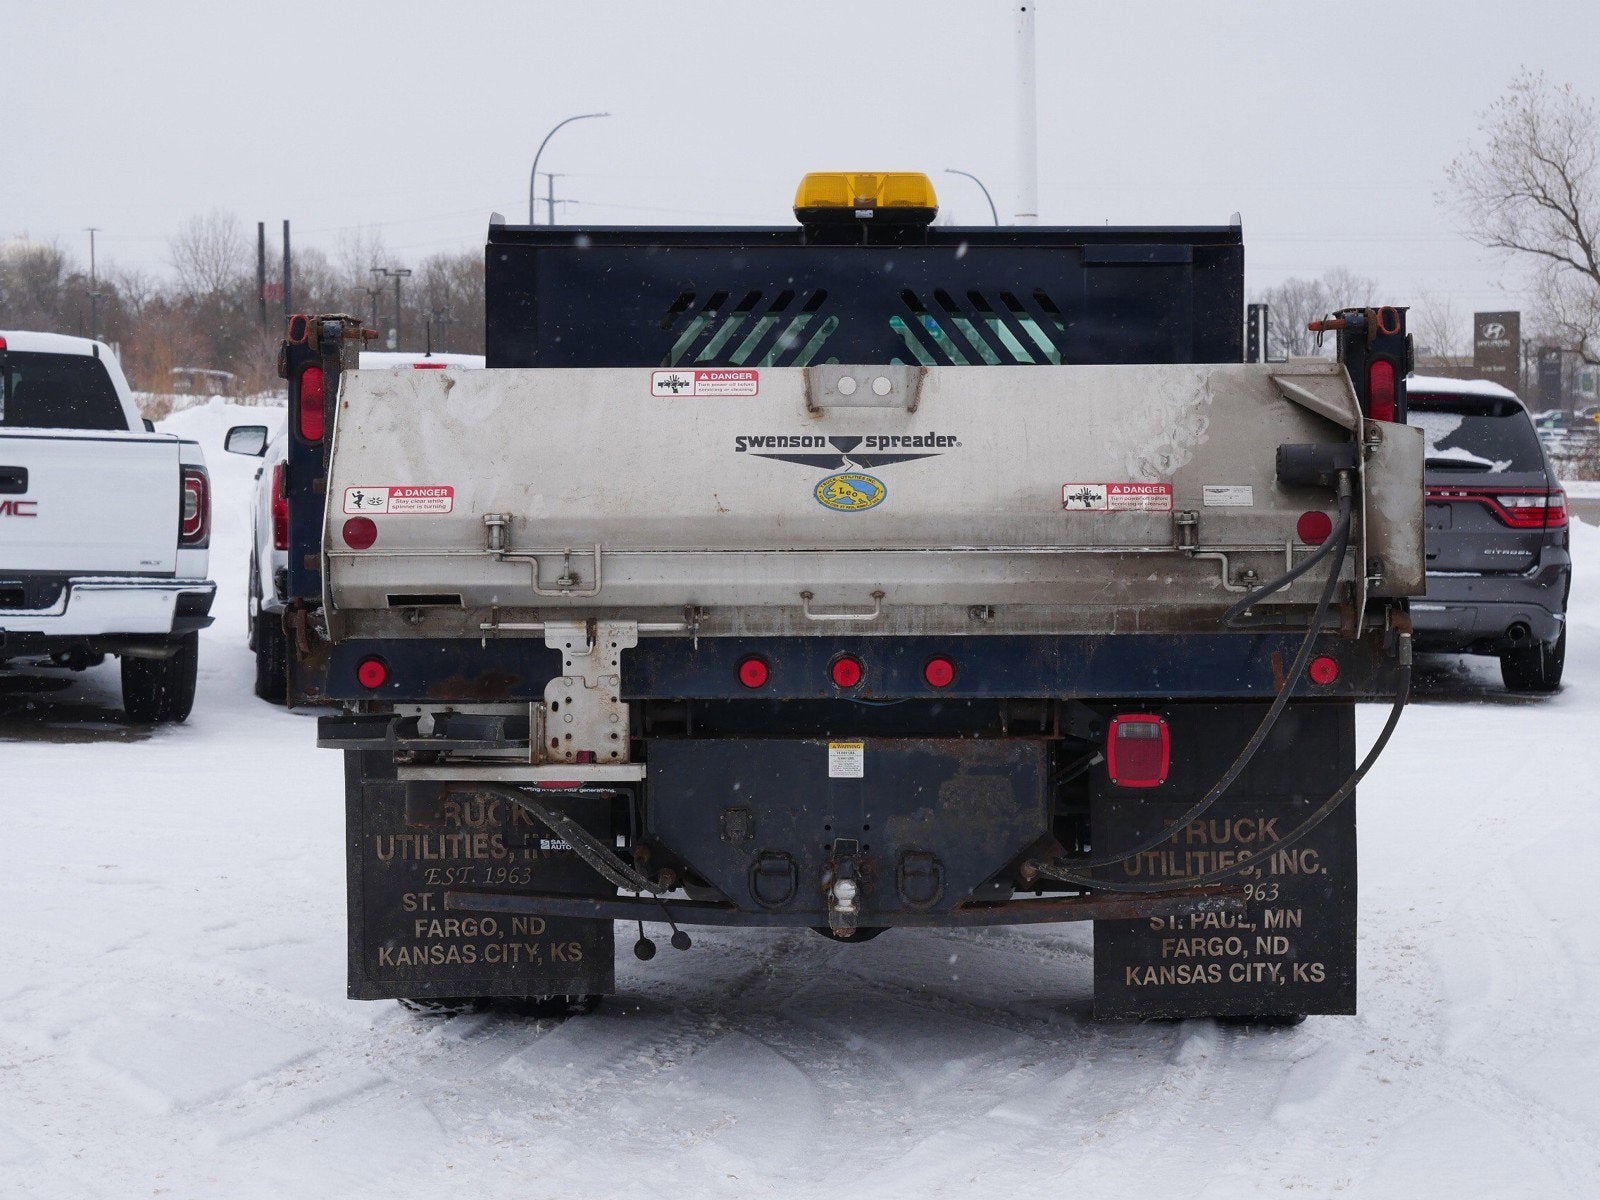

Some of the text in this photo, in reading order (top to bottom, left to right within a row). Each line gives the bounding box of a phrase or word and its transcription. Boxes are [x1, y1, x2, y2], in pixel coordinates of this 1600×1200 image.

[711, 372, 752, 380] DANGER
[405, 489, 448, 497] DANGER
[1123, 486, 1166, 494] DANGER
[0, 500, 38, 516] MC
[443, 800, 534, 827] RUCK
[1164, 817, 1280, 844] TRUCK
[376, 833, 516, 863] UTILITIES,
[1123, 848, 1327, 880] UTILITIES, INC.
[424, 865, 532, 886] EST. 1963
[402, 893, 436, 912] ST.
[1243, 883, 1279, 901] 963
[415, 917, 546, 939] FARGO, ND
[1264, 908, 1302, 929] MN
[378, 942, 583, 967] KANSAS CITY, KS
[1162, 936, 1289, 959] FARGO, ND
[1126, 962, 1326, 986] KANSAS CITY, KS
